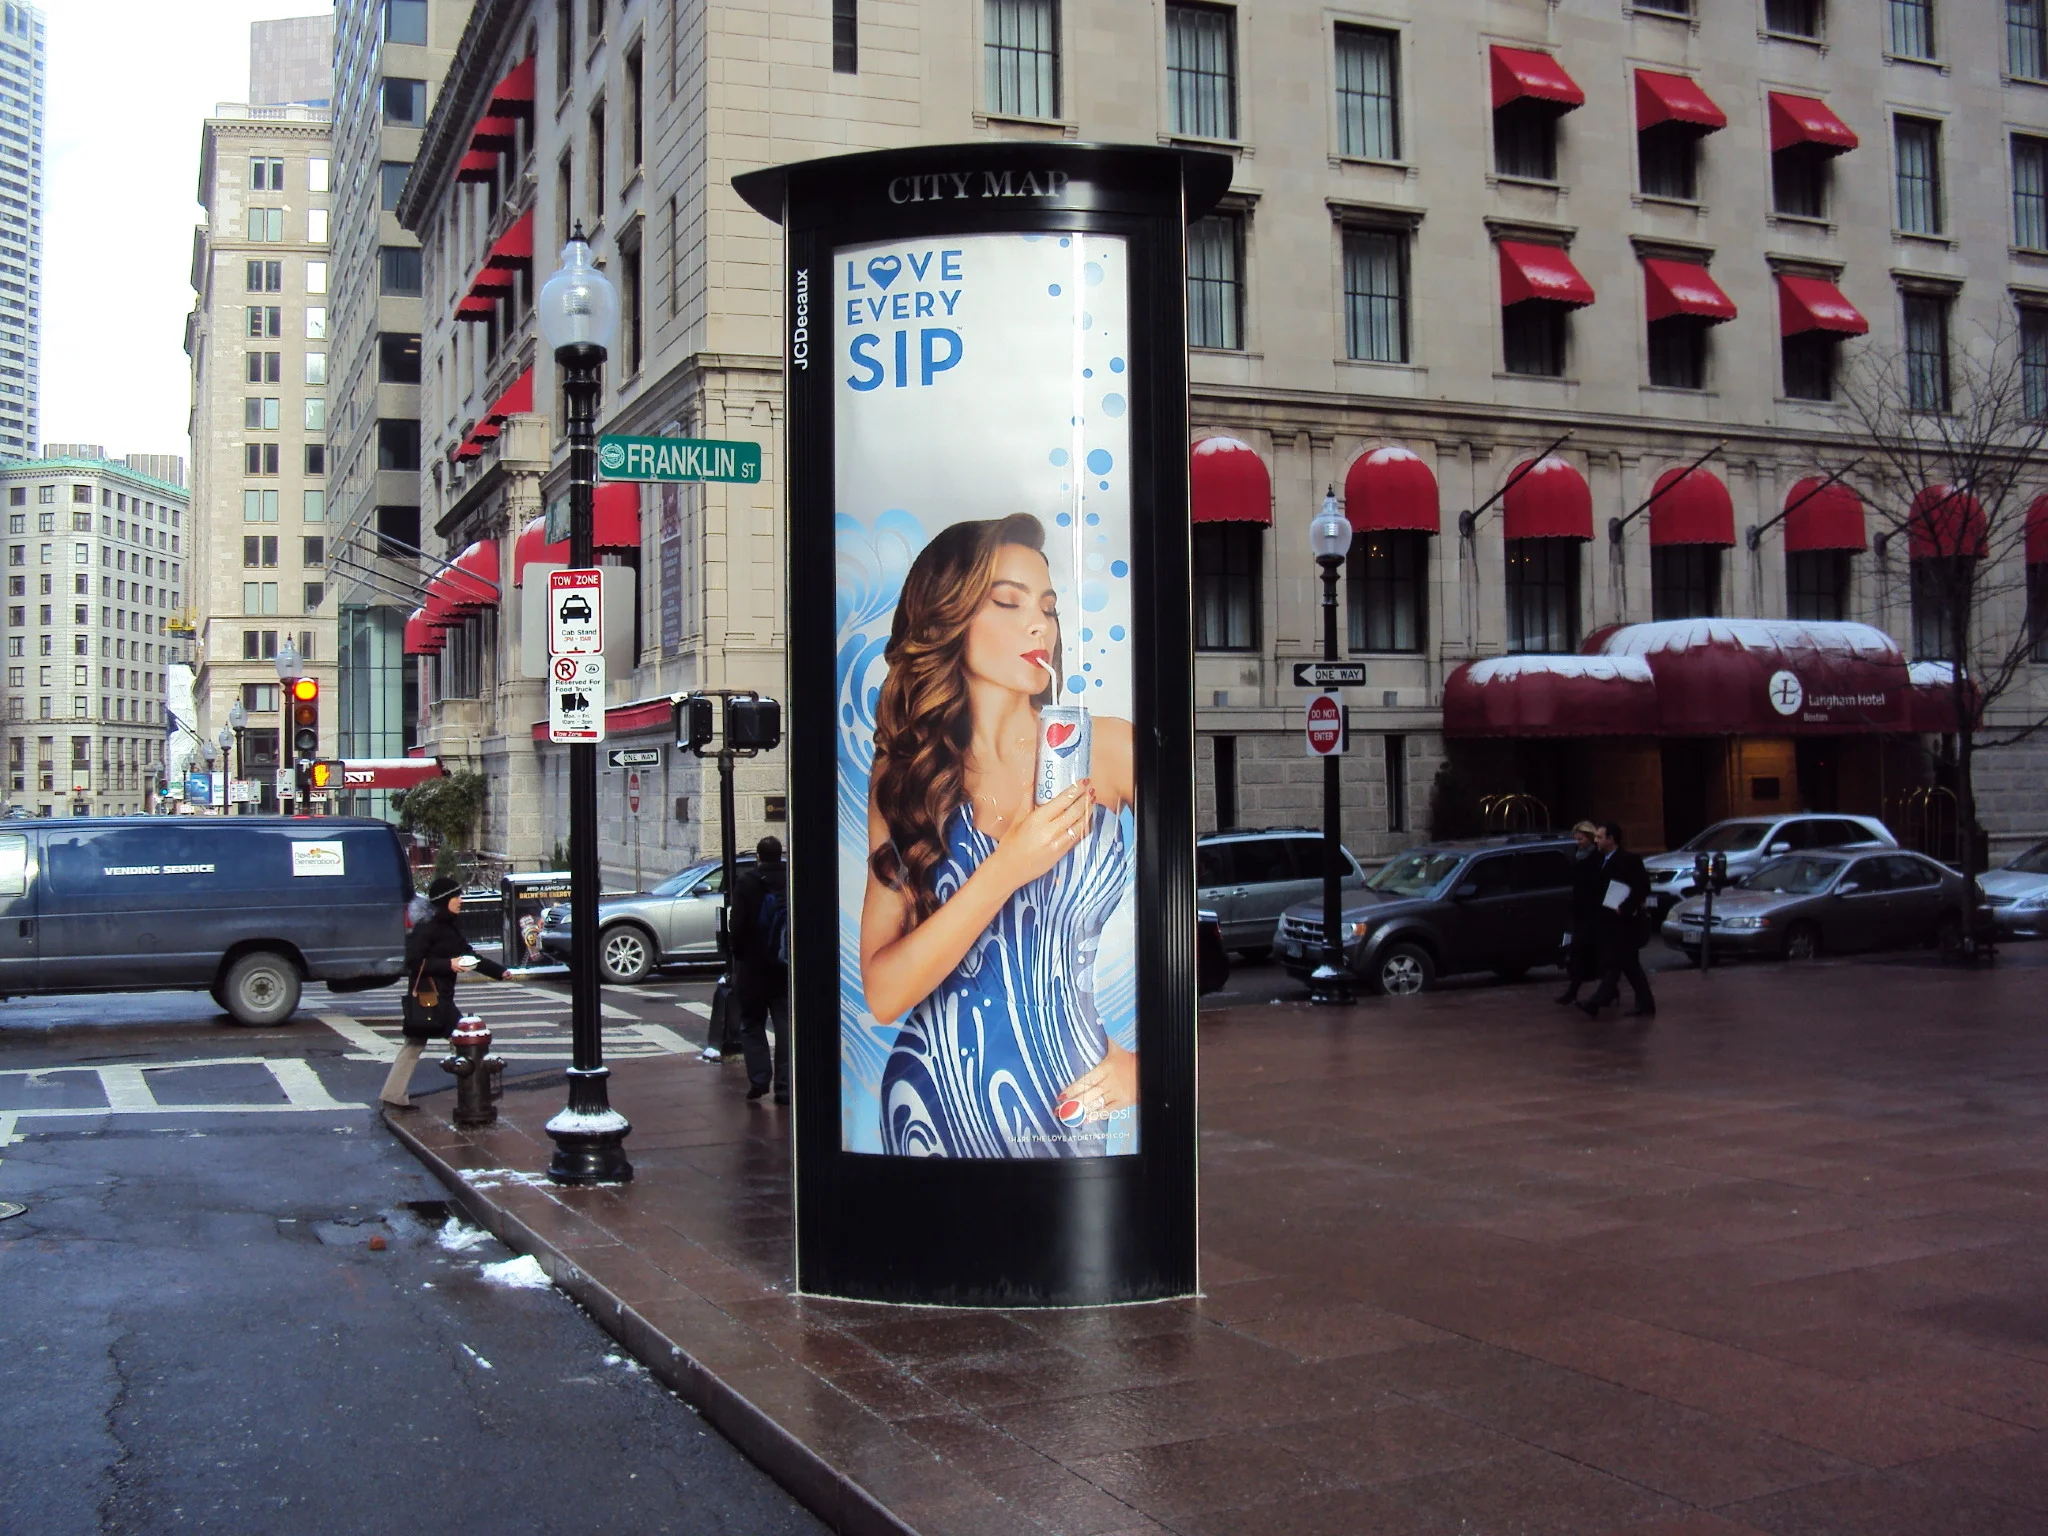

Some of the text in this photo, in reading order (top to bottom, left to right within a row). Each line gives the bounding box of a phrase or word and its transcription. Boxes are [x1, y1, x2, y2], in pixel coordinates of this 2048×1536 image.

[888, 170, 1069, 204] CITY MAP
[847, 289, 962, 326] EVERY
[793, 268, 809, 371] JCDecaux
[846, 327, 963, 392] SIP
[627, 443, 756, 479] FRANKLIN ST
[552, 574, 599, 586] TOW ZONE
[577, 628, 597, 636] Stand
[1315, 670, 1360, 680] ONE WAY
[1808, 692, 1886, 710] Langham Hotel
[1311, 709, 1336, 719] DO NOT
[1313, 732, 1334, 741] ENTER
[104, 864, 215, 876] VENDING SERVICE
[1088, 1106, 1130, 1123] pepsi
[1048, 1134, 1067, 1142] LOVE
